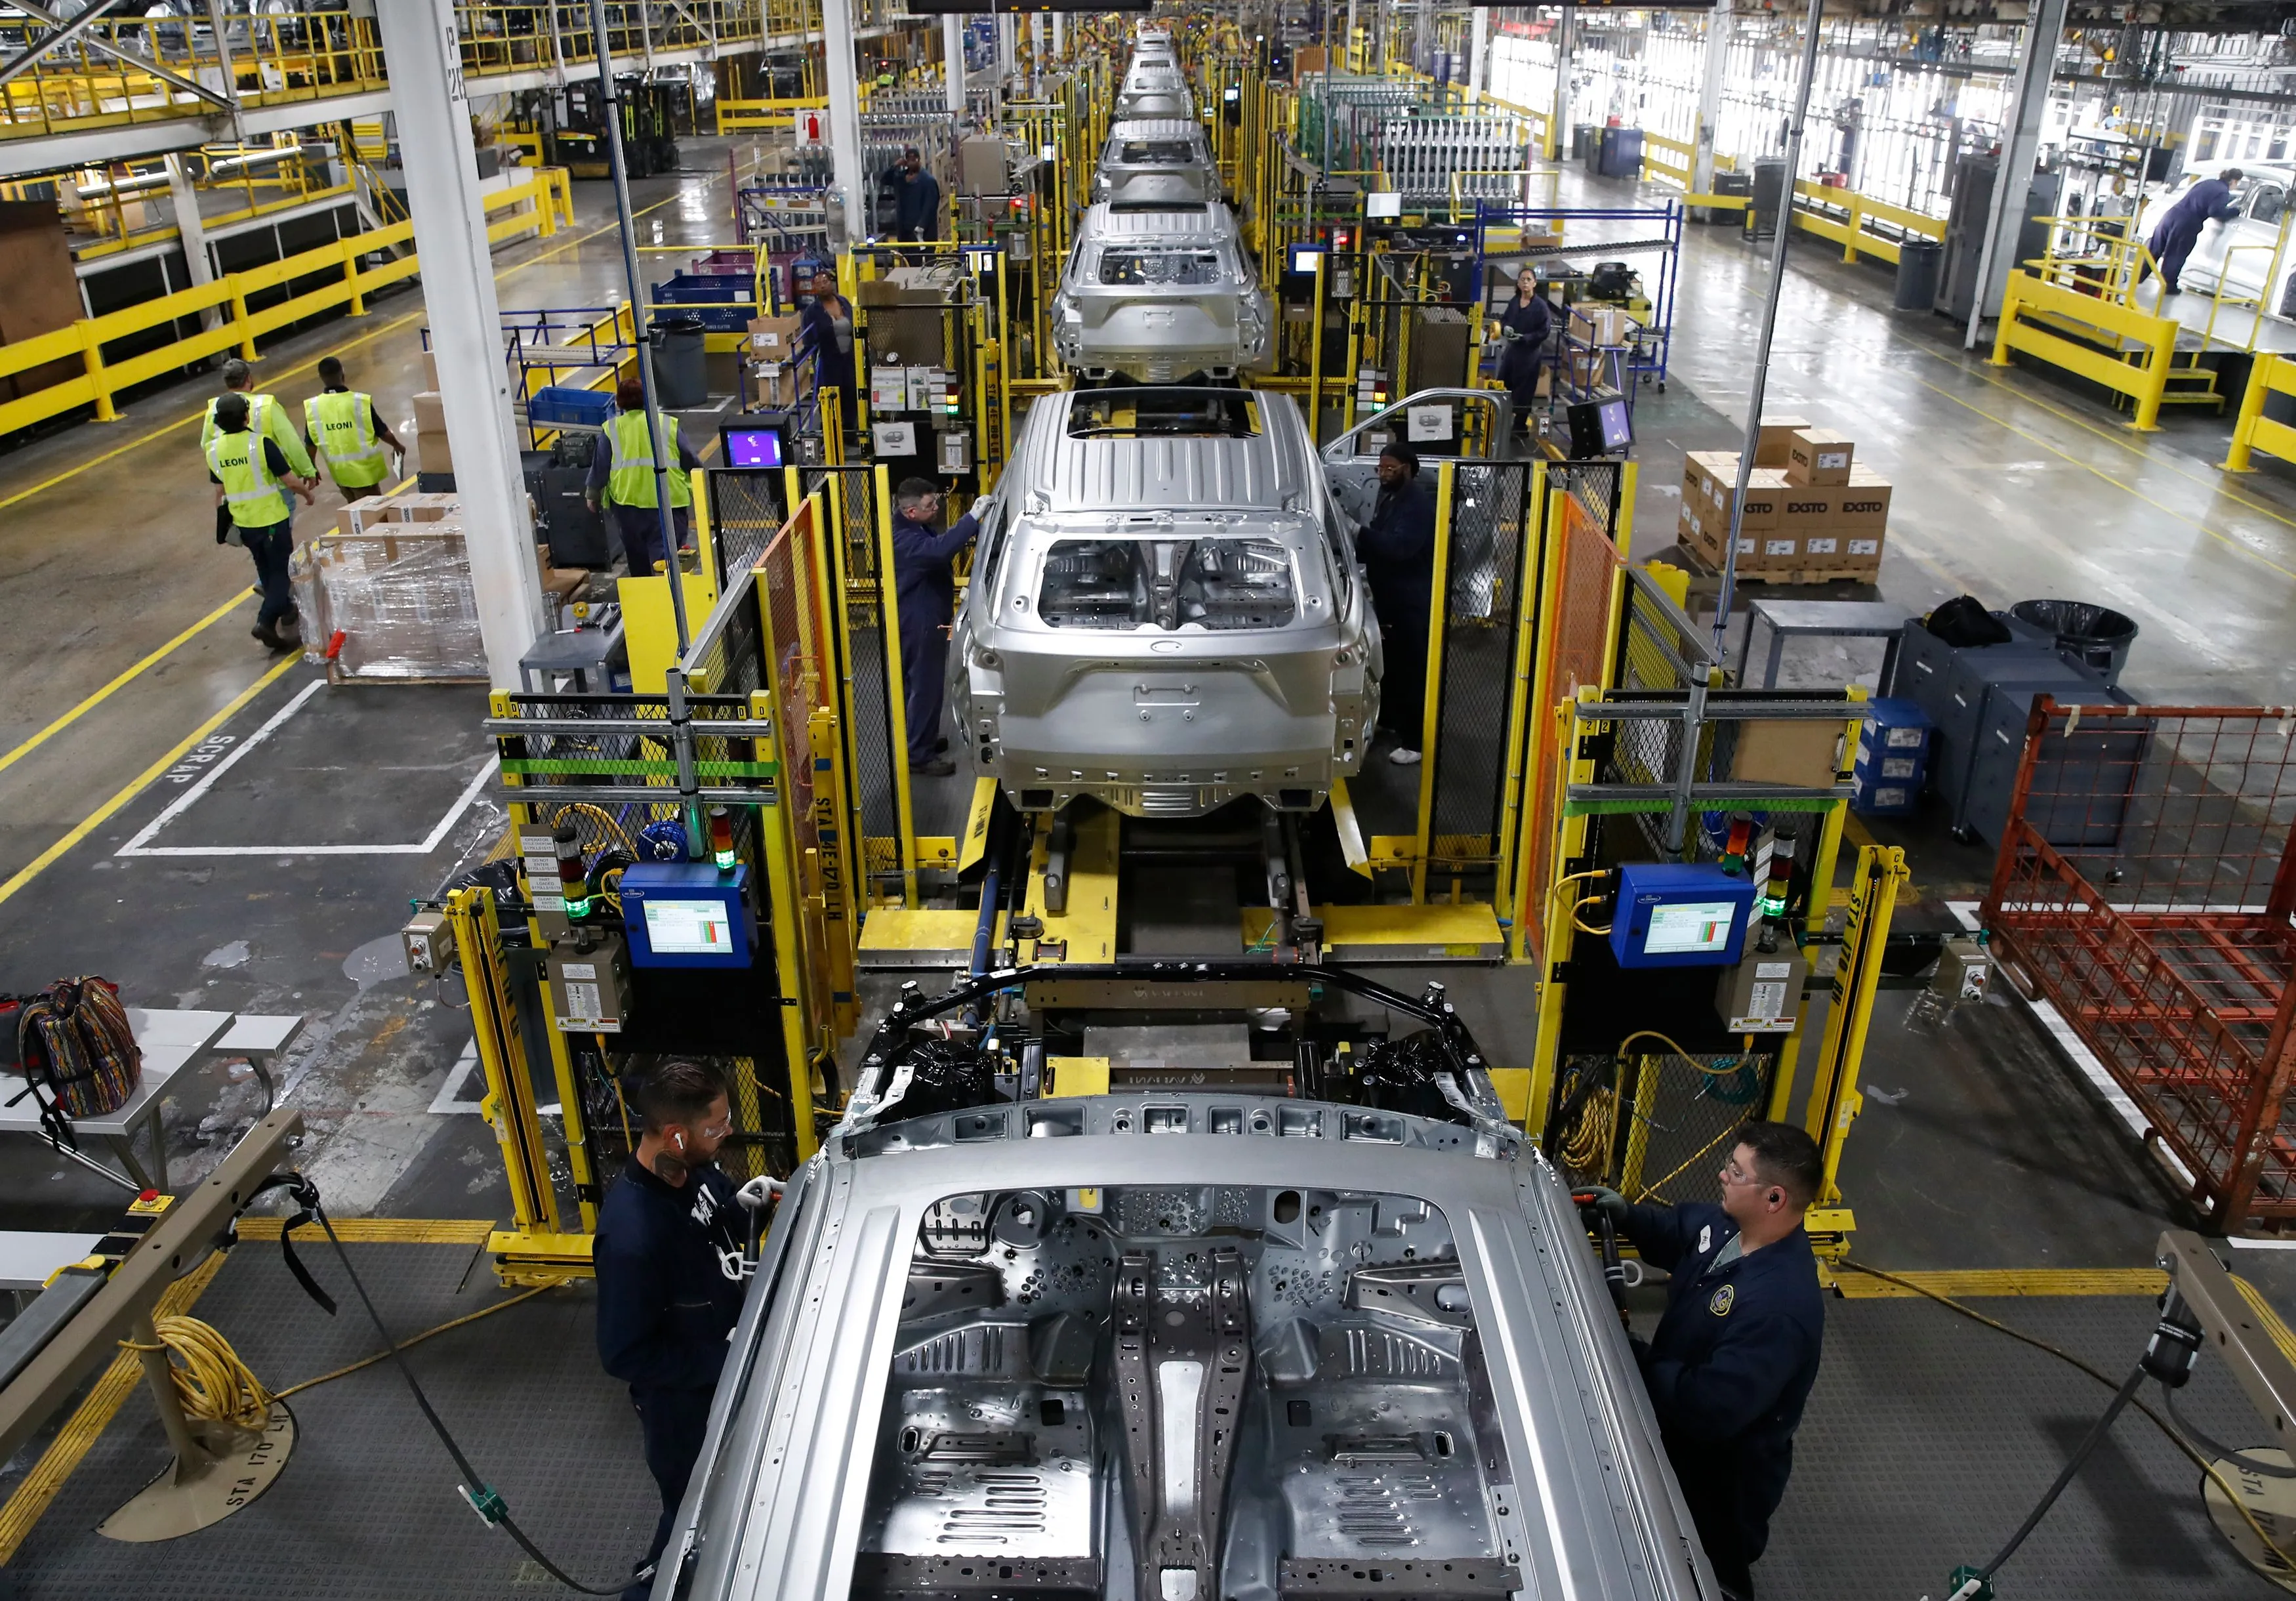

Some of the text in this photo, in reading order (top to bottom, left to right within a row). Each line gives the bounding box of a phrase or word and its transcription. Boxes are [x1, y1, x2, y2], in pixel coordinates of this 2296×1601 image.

[326, 421, 353, 431] LEONI
[220, 457, 249, 468] LEONI
[1792, 449, 1809, 468] EXSTO
[1788, 502, 1828, 514] EXSTO
[1842, 501, 1883, 512] EXSTO
[165, 735, 236, 783] SCRAP
[816, 797, 833, 826] STA
[827, 902, 843, 920] LH
[1831, 893, 1861, 1007] STA 170 RH
[226, 1477, 256, 1506] STA
[247, 1443, 274, 1465] 170
